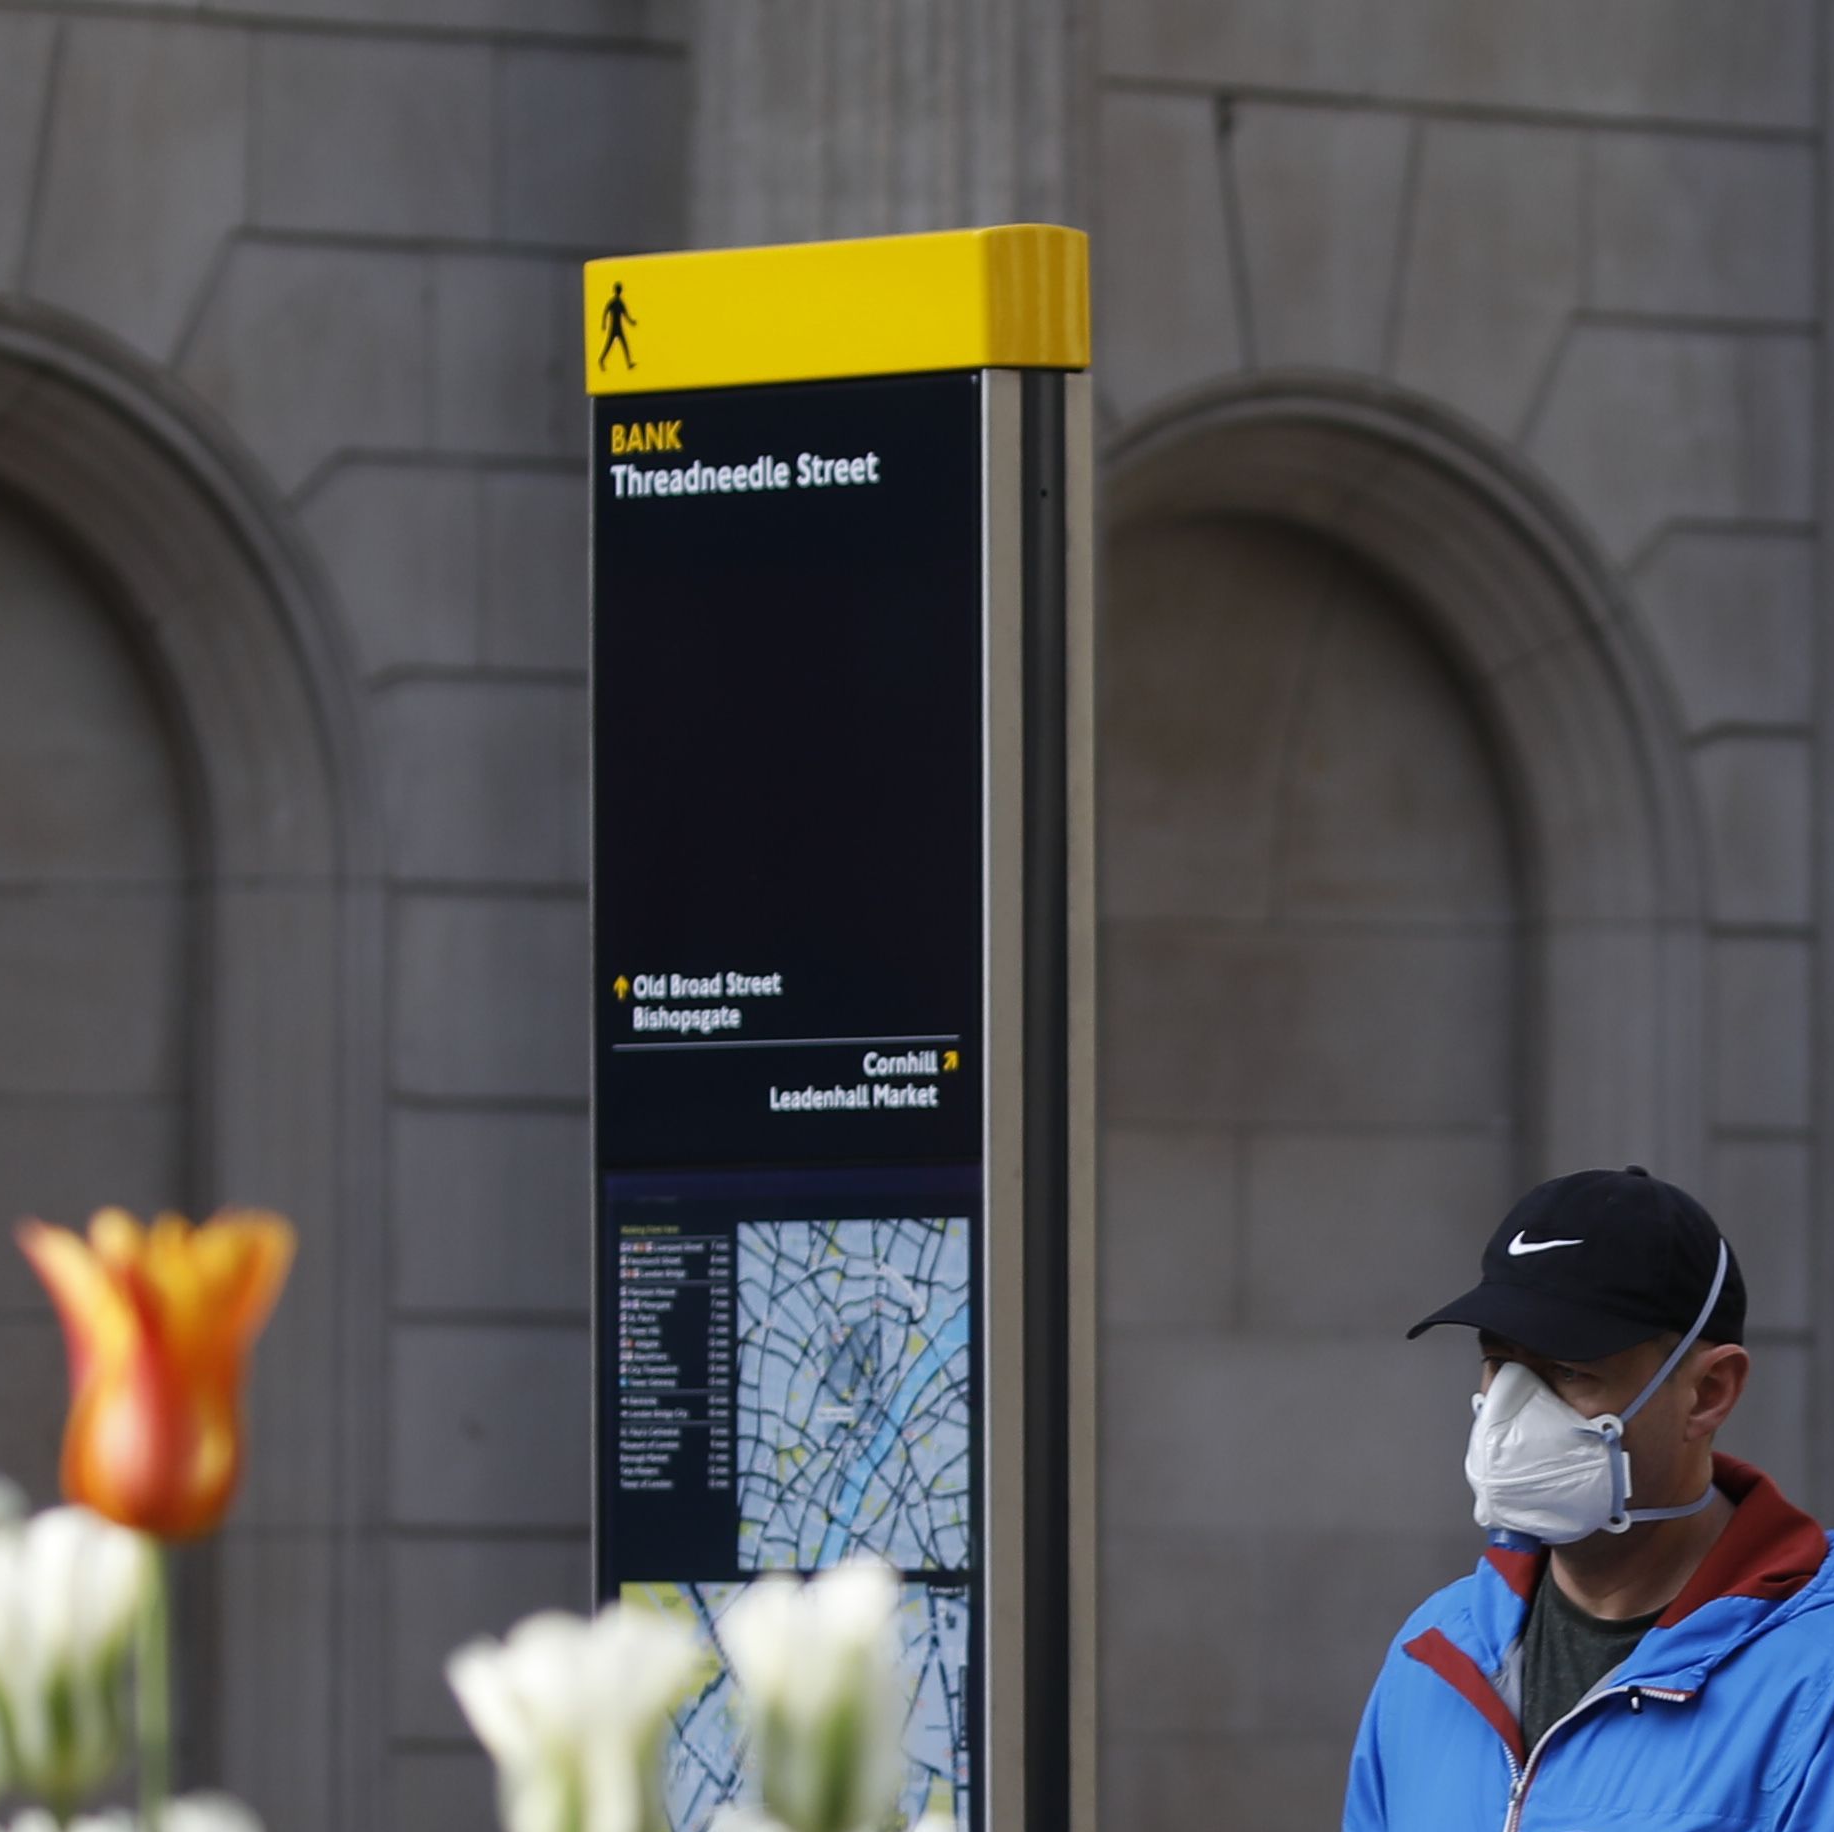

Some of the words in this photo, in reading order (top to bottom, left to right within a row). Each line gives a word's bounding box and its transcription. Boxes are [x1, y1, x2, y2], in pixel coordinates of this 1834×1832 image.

[611, 420, 682, 454] BANK
[610, 455, 790, 498] Threadneedle
[797, 452, 879, 486] Street
[633, 975, 667, 999] Old
[670, 973, 722, 998] Broad
[726, 972, 781, 996] Street
[633, 1006, 741, 1034] Bishopsgate
[863, 1051, 938, 1076] Cornhill
[770, 1084, 870, 1110] Leadenhall
[873, 1083, 938, 1107] Market
